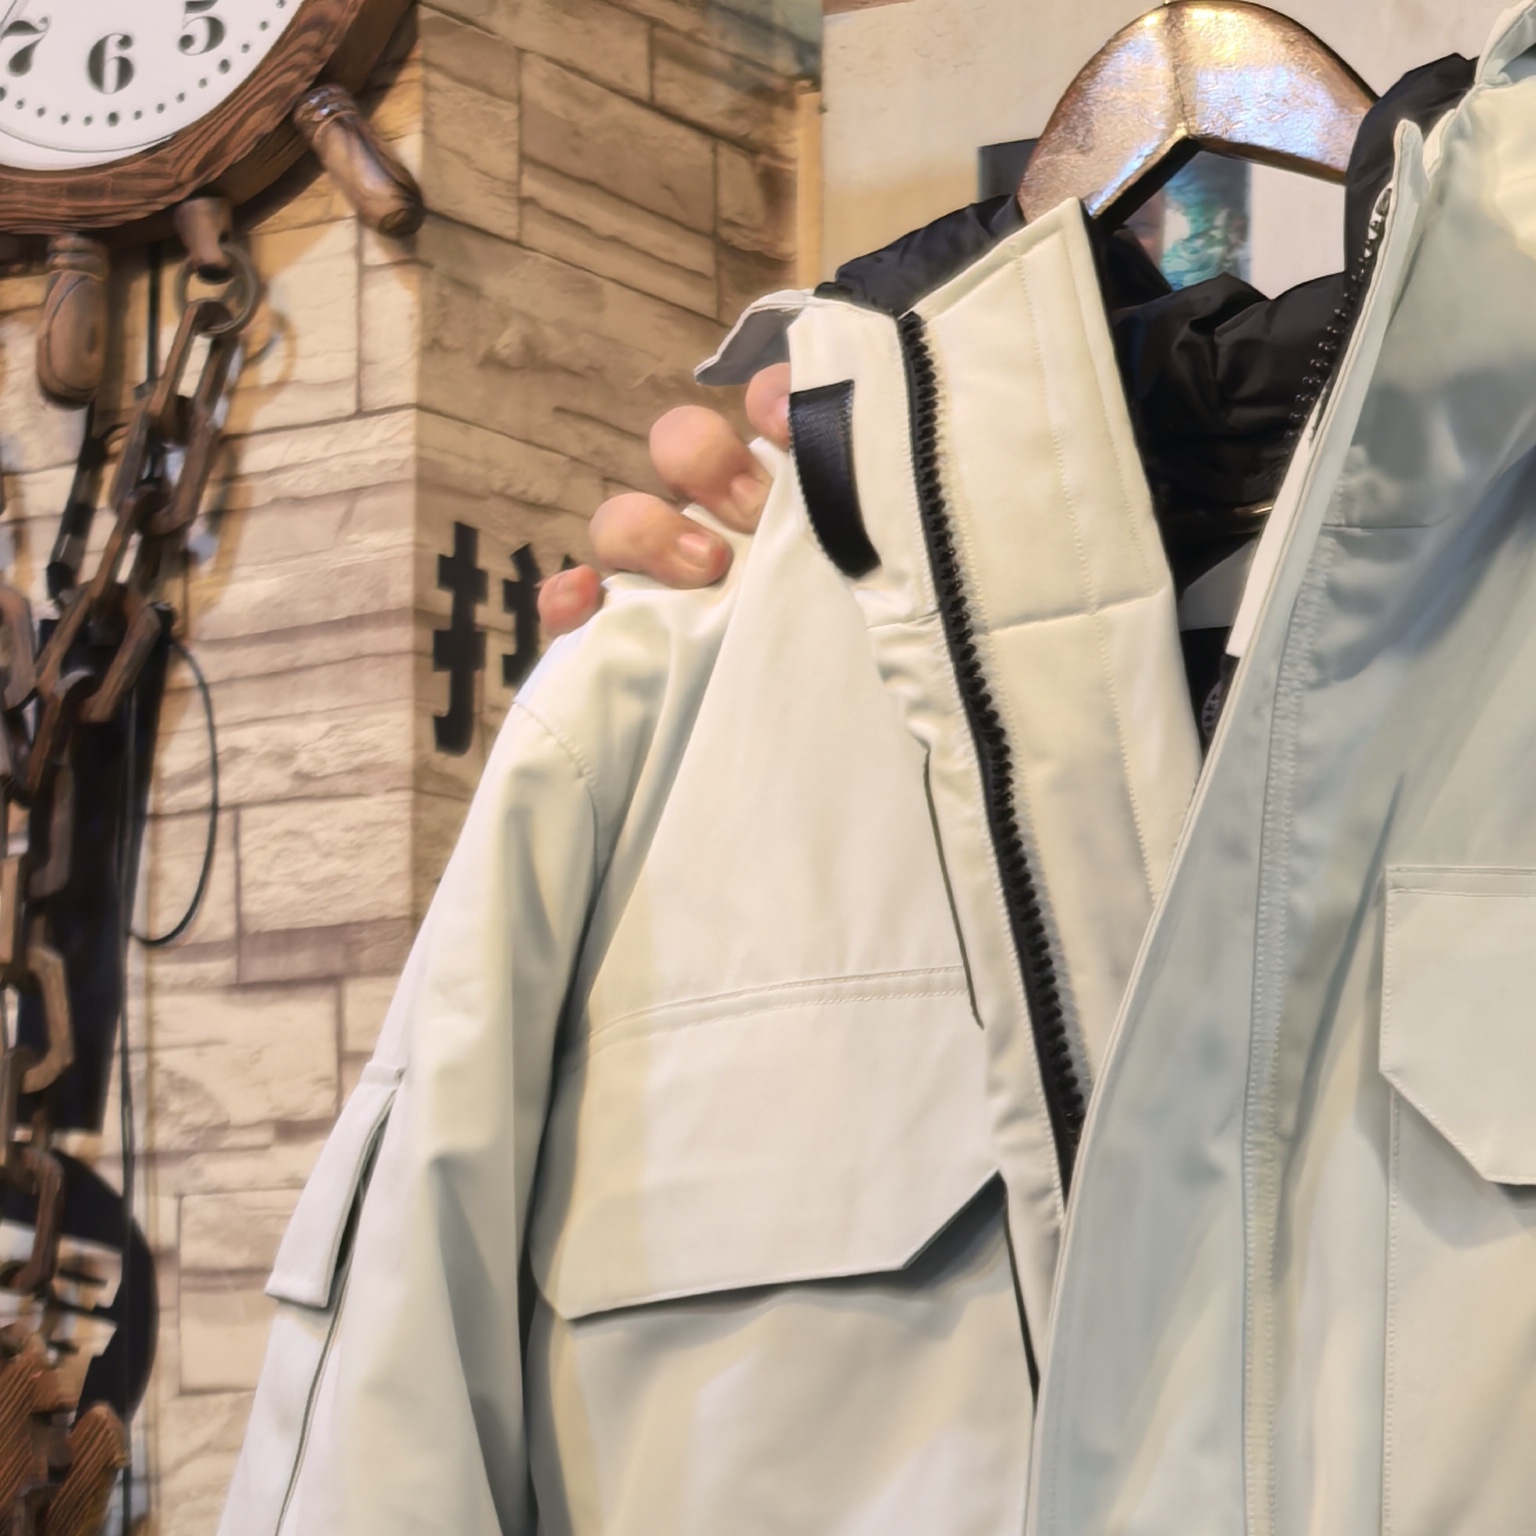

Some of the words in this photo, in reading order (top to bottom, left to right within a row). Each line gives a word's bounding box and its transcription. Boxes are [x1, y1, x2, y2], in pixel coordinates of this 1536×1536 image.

[0, 16, 50, 77] 7
[178, 0, 225, 55] 5
[87, 33, 134, 94] 6
